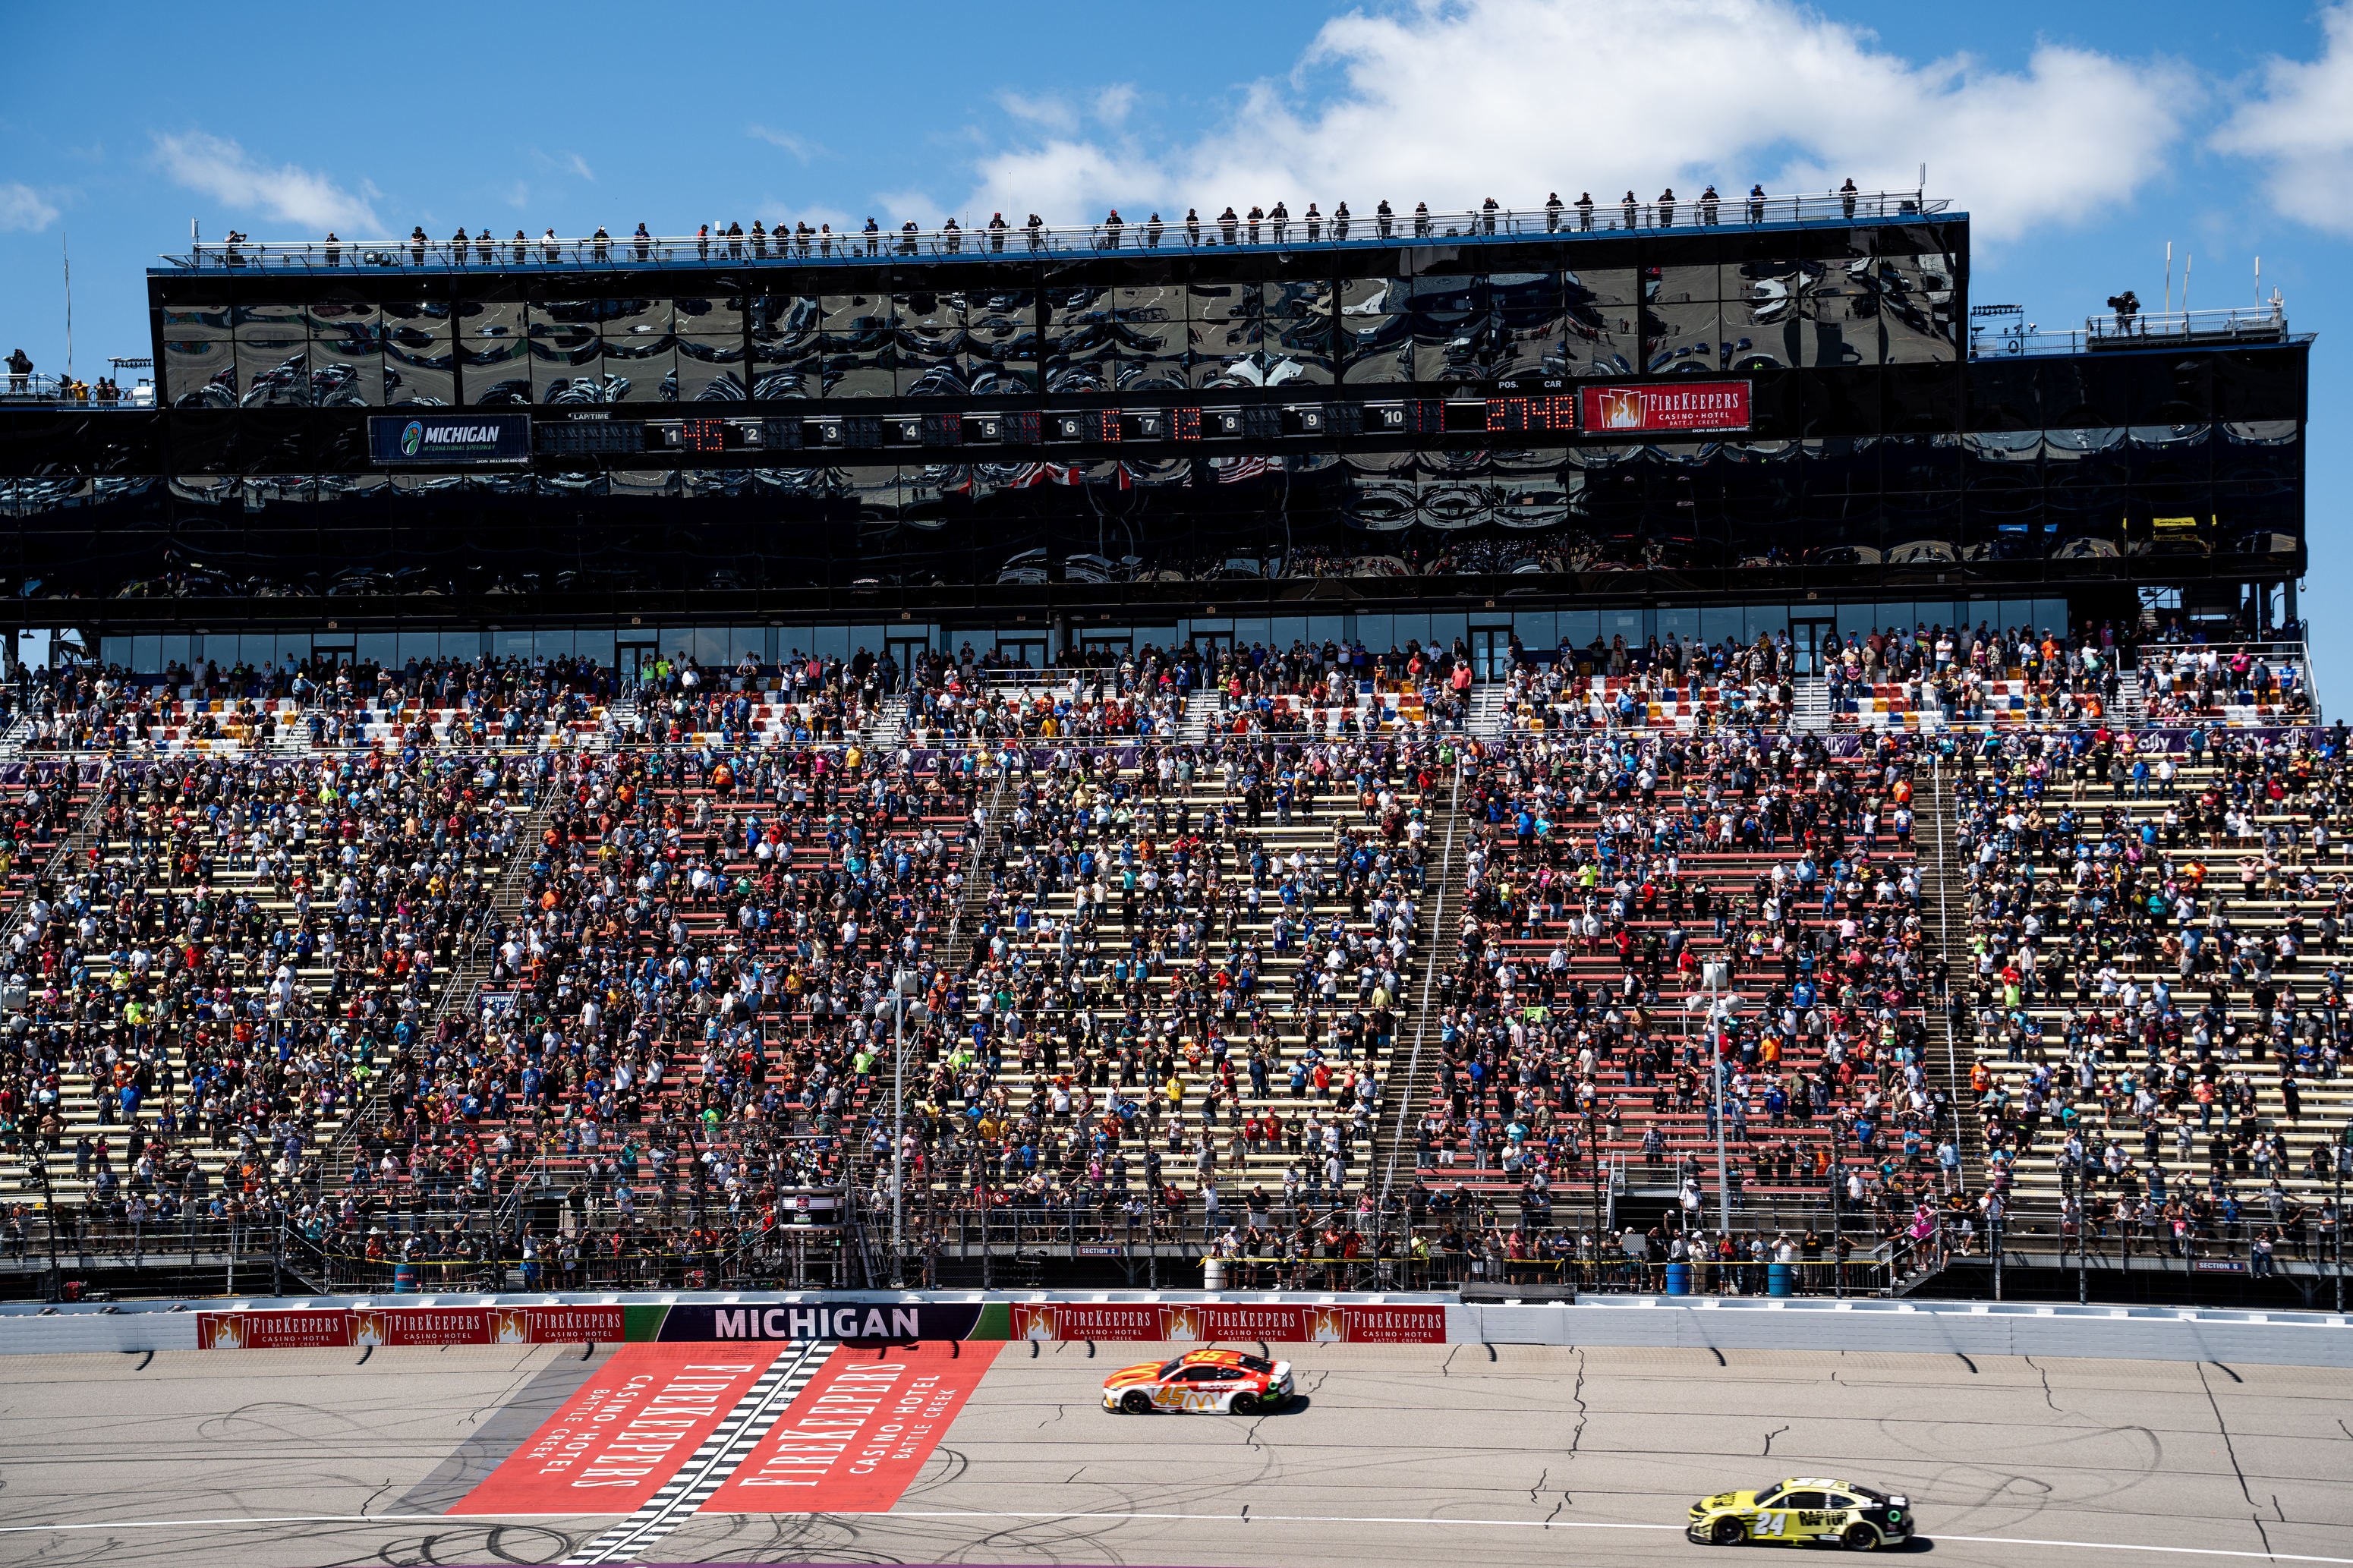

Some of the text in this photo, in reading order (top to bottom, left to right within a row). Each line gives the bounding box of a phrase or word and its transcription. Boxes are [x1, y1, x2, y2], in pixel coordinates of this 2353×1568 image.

[1650, 393, 1739, 411] FIREKEEPERS
[1146, 419, 1154, 431] 7
[1226, 417, 1235, 429] 8
[1308, 414, 1317, 426] 9
[1385, 411, 1403, 423] 10
[424, 426, 500, 443] MICHIGAN
[748, 428, 758, 440] 2
[827, 427, 836, 439] 3
[906, 426, 916, 437] 4
[986, 423, 996, 435] 5
[1066, 421, 1075, 433] 6
[669, 430, 677, 442] 1
[253, 1317, 339, 1333] FIREKEEPERS
[395, 1315, 480, 1330] FIREKEEPERS
[537, 1312, 620, 1329] FIREKEEPERS
[714, 1308, 919, 1338] MICHIGAN
[1065, 1310, 1151, 1327] FIREKEEPERS
[1208, 1310, 1295, 1327] FIREKEEPERS
[1354, 1311, 1441, 1329] FIREKEEPERS
[1186, 1351, 1227, 1362] 45
[1154, 1387, 1189, 1406] 45
[526, 1389, 611, 1459] BATTLE CREEK
[539, 1375, 654, 1475] CASINO HOTEL
[571, 1364, 755, 1487] FIREKEEPERS
[739, 1364, 906, 1487] FIREKEEPERS
[849, 1375, 940, 1474] CASINO HOTEL
[892, 1390, 957, 1459] BATTLE CREEK
[1753, 1511, 1788, 1536] 24
